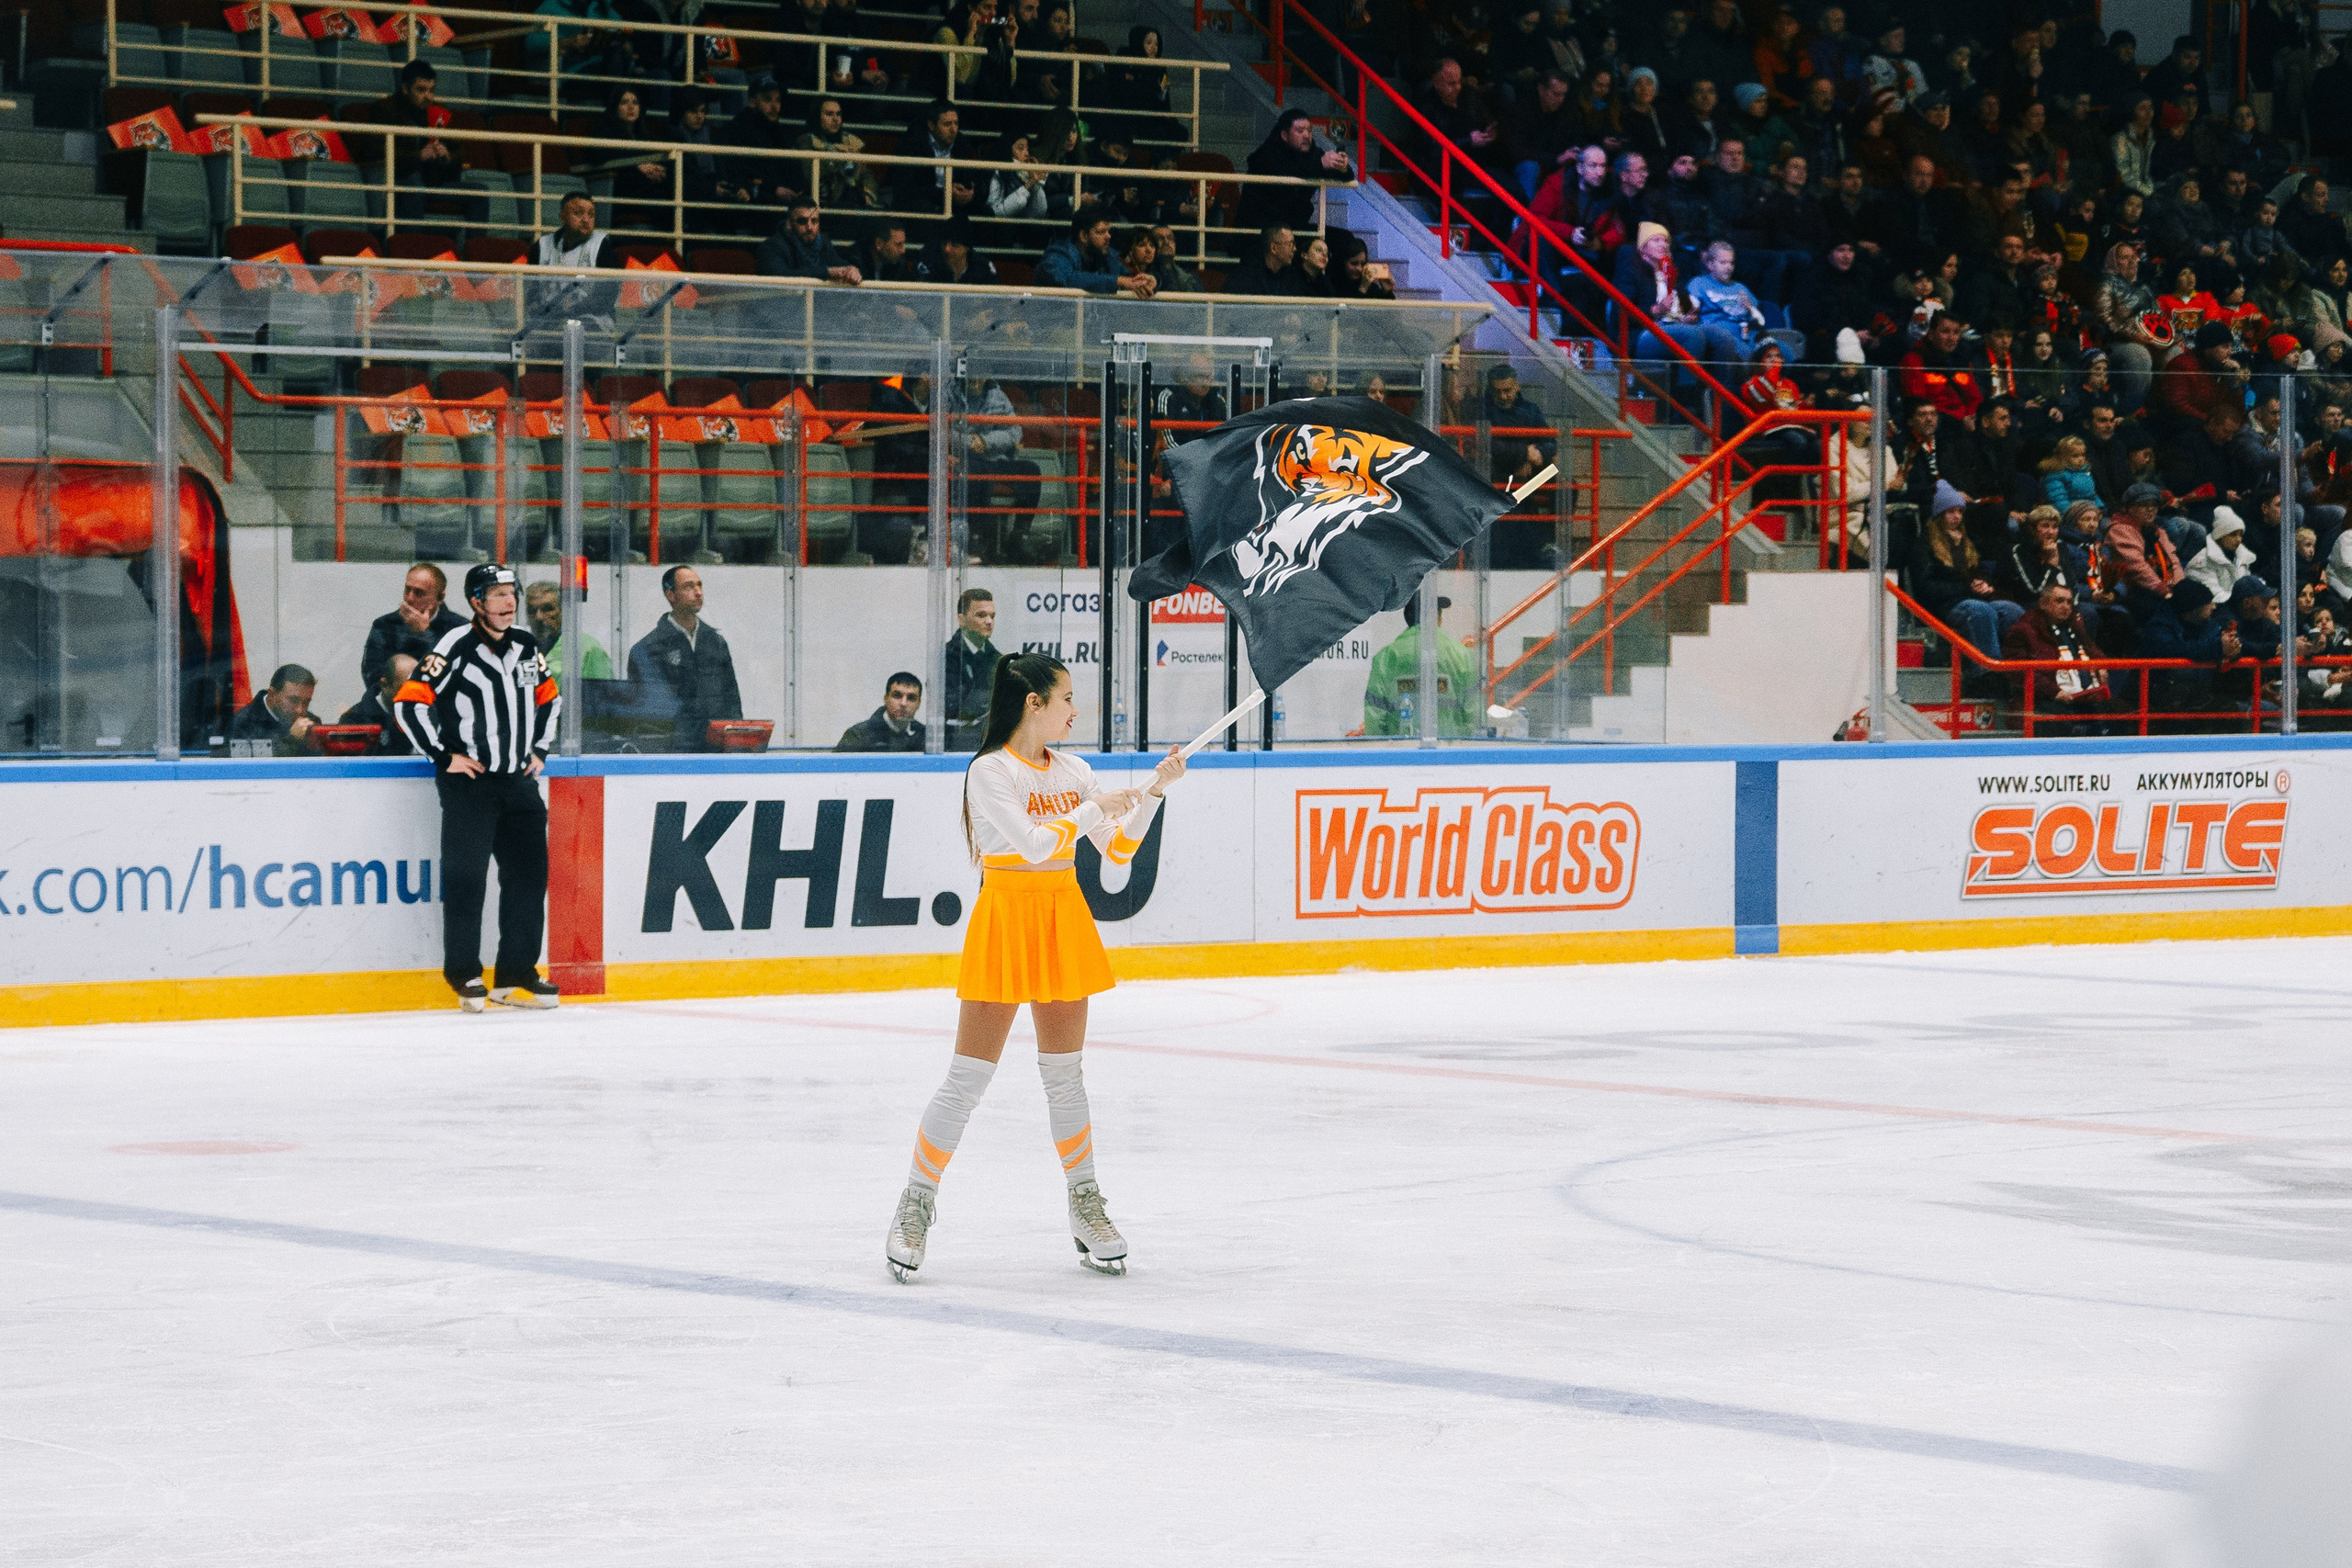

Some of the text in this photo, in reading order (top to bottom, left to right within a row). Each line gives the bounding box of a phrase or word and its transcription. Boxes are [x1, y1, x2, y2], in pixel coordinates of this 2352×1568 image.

[1153, 592, 1226, 615] FONBE
[1171, 650, 1225, 663] Ростелек
[1318, 640, 1369, 660] UR.RU
[420, 653, 447, 678] 35
[1978, 774, 2111, 794] WWW.SOLITE.RU
[2136, 771, 2269, 791] АККУМУЛЯТОРЫ
[1026, 790, 1080, 817] AMUR
[1308, 804, 1628, 900] World Class
[1967, 800, 2290, 880] SOLITE
[640, 795, 1166, 933] KHL.U
[0, 844, 445, 916] .com/hcamu
